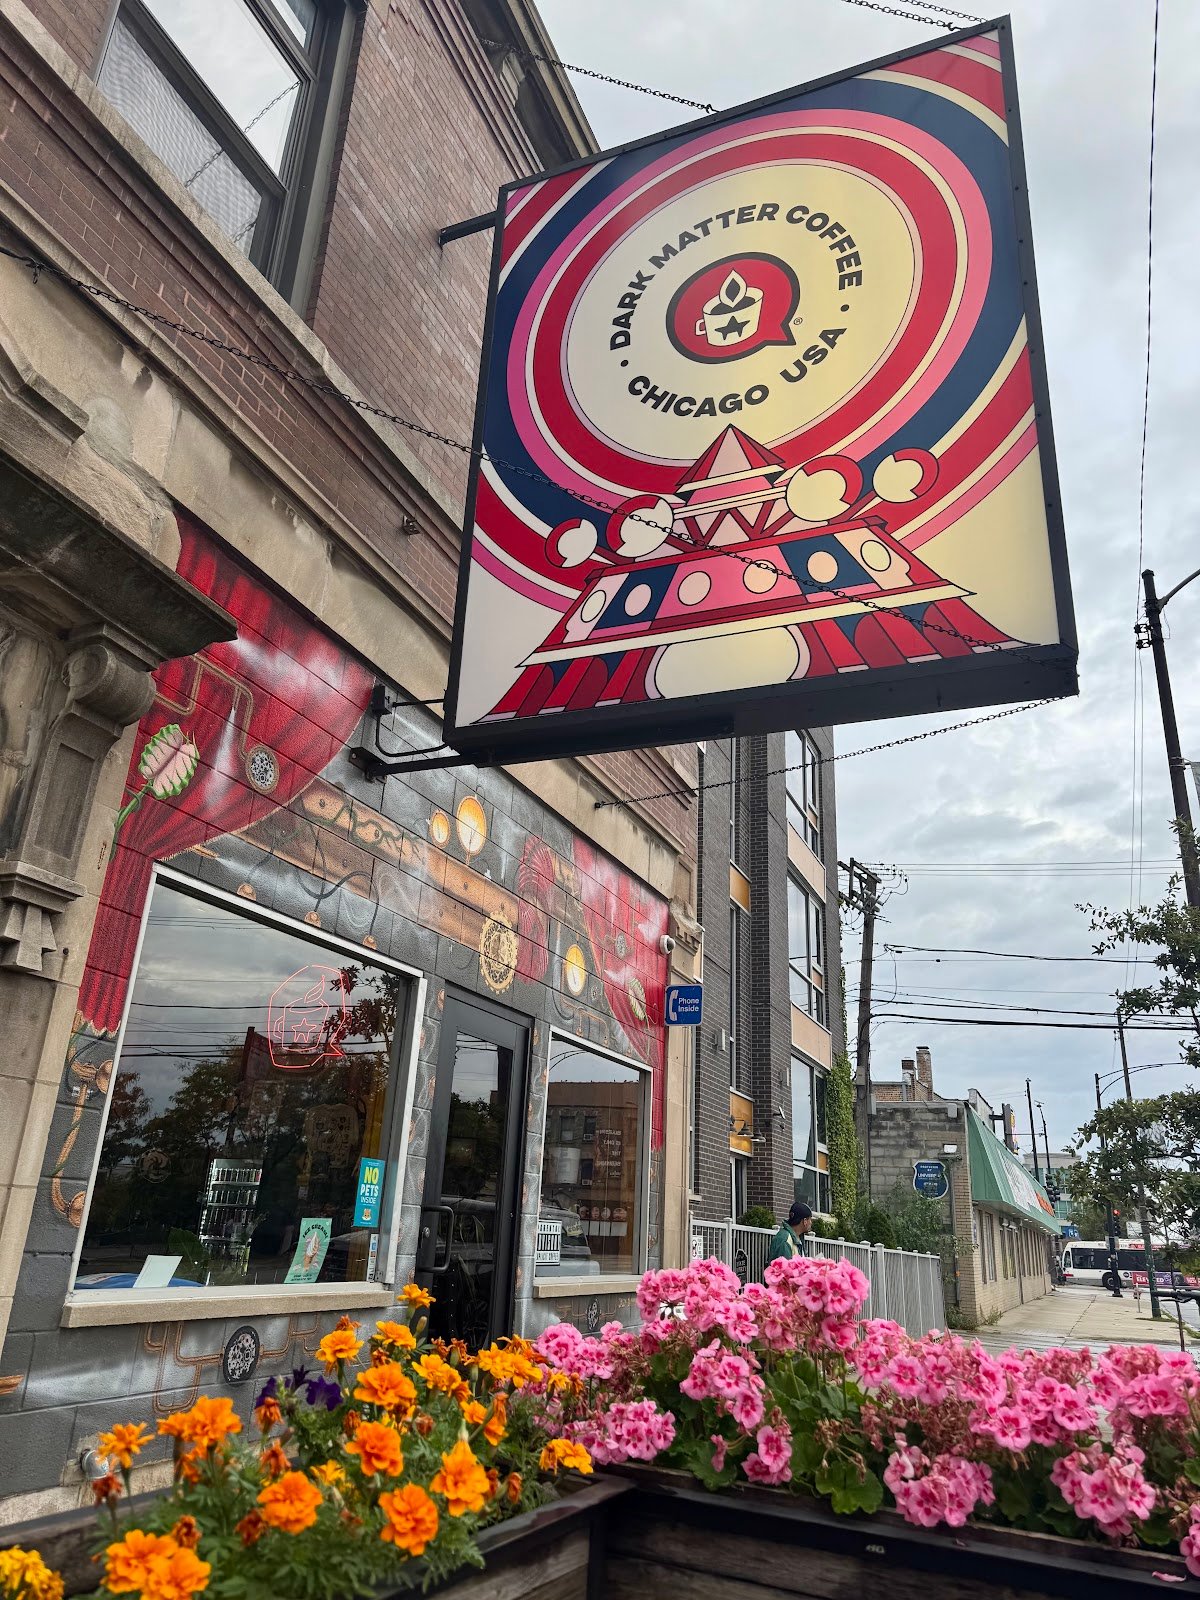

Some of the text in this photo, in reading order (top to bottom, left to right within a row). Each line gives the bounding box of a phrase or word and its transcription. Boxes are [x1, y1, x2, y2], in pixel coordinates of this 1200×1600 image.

[610, 203, 863, 350] DARK MATTER COFFEE
[628, 327, 847, 418] CHICAGO USA
[363, 1167, 379, 1184] NO
[360, 1183, 379, 1197] PETS
[360, 1196, 377, 1204] INSIDE
